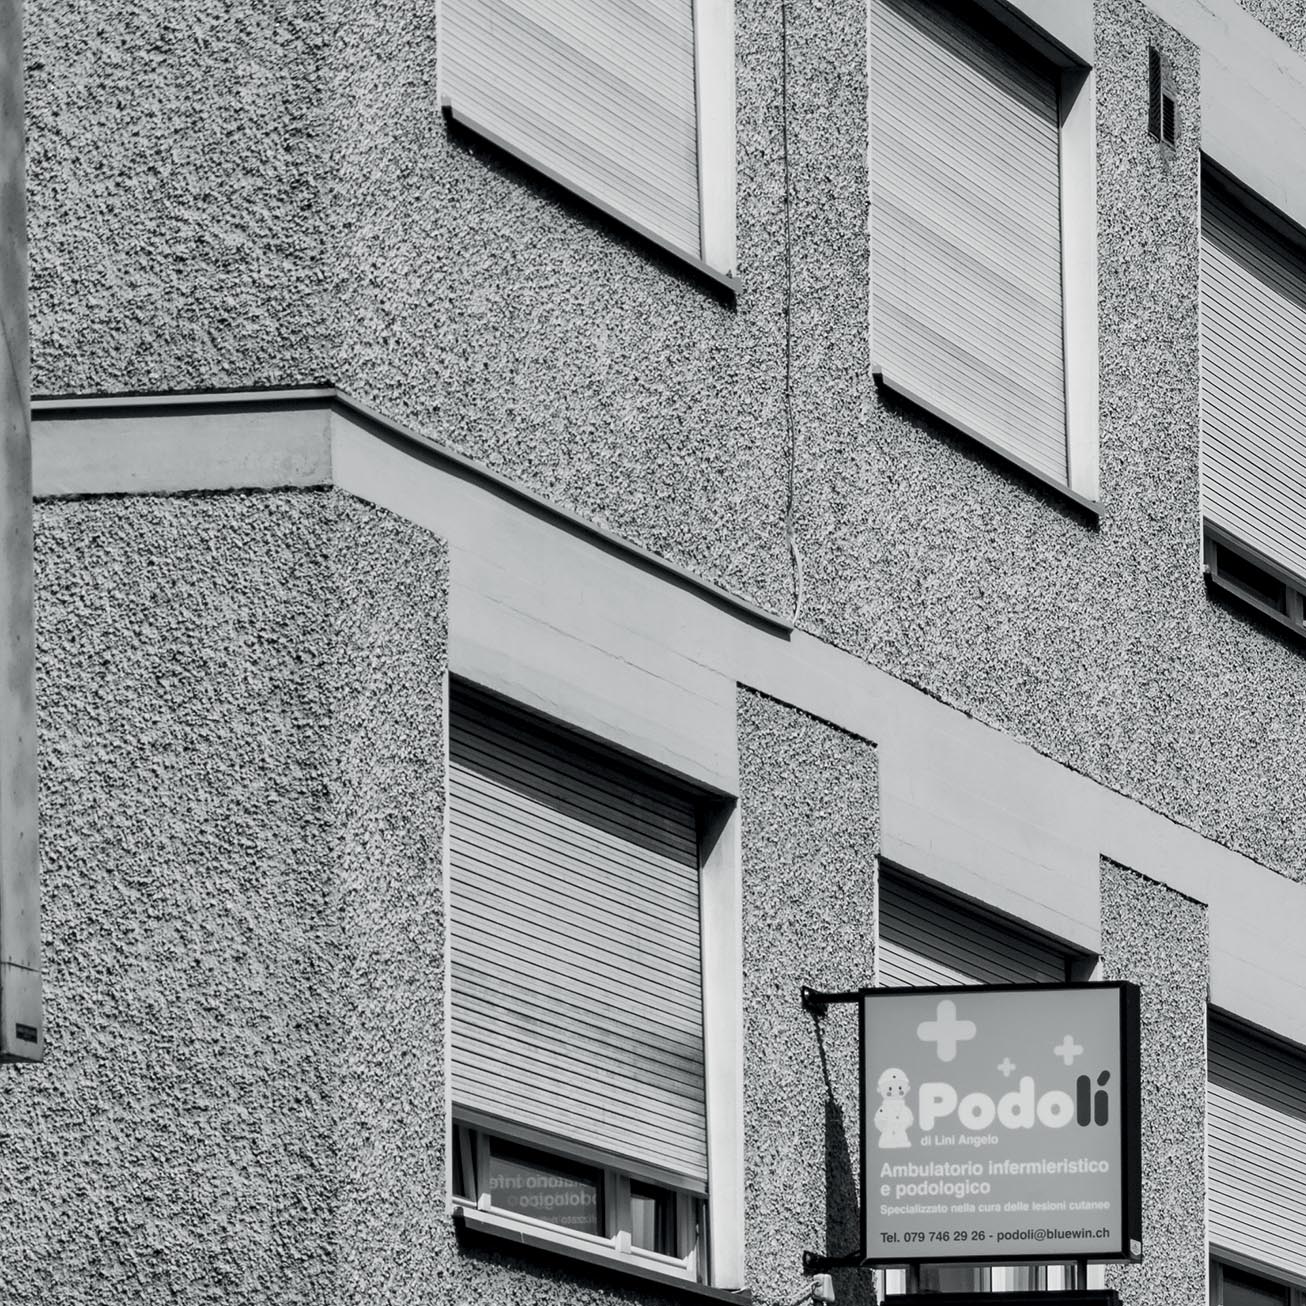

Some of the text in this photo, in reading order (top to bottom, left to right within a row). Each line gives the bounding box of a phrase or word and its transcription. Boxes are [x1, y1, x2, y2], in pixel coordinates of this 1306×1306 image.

[919, 1070, 1110, 1131] Podolí
[920, 1135, 999, 1147] di Lini Angelo
[880, 1158, 1109, 1178] Ambulatorio infermieristico
[880, 1180, 991, 1199] e podologico
[880, 1203, 948, 1216] Specializzato
[951, 1202, 976, 1213] nella
[978, 1203, 1001, 1212] cura
[1032, 1201, 1066, 1211] lesioni
[880, 1232, 900, 1243] Tel.
[904, 1232, 925, 1243] 079
[929, 1231, 950, 1242] 746
[953, 1231, 968, 1242] 29
[971, 1230, 985, 1241] 26
[997, 1227, 1110, 1243] podoli@bluewin.ch
